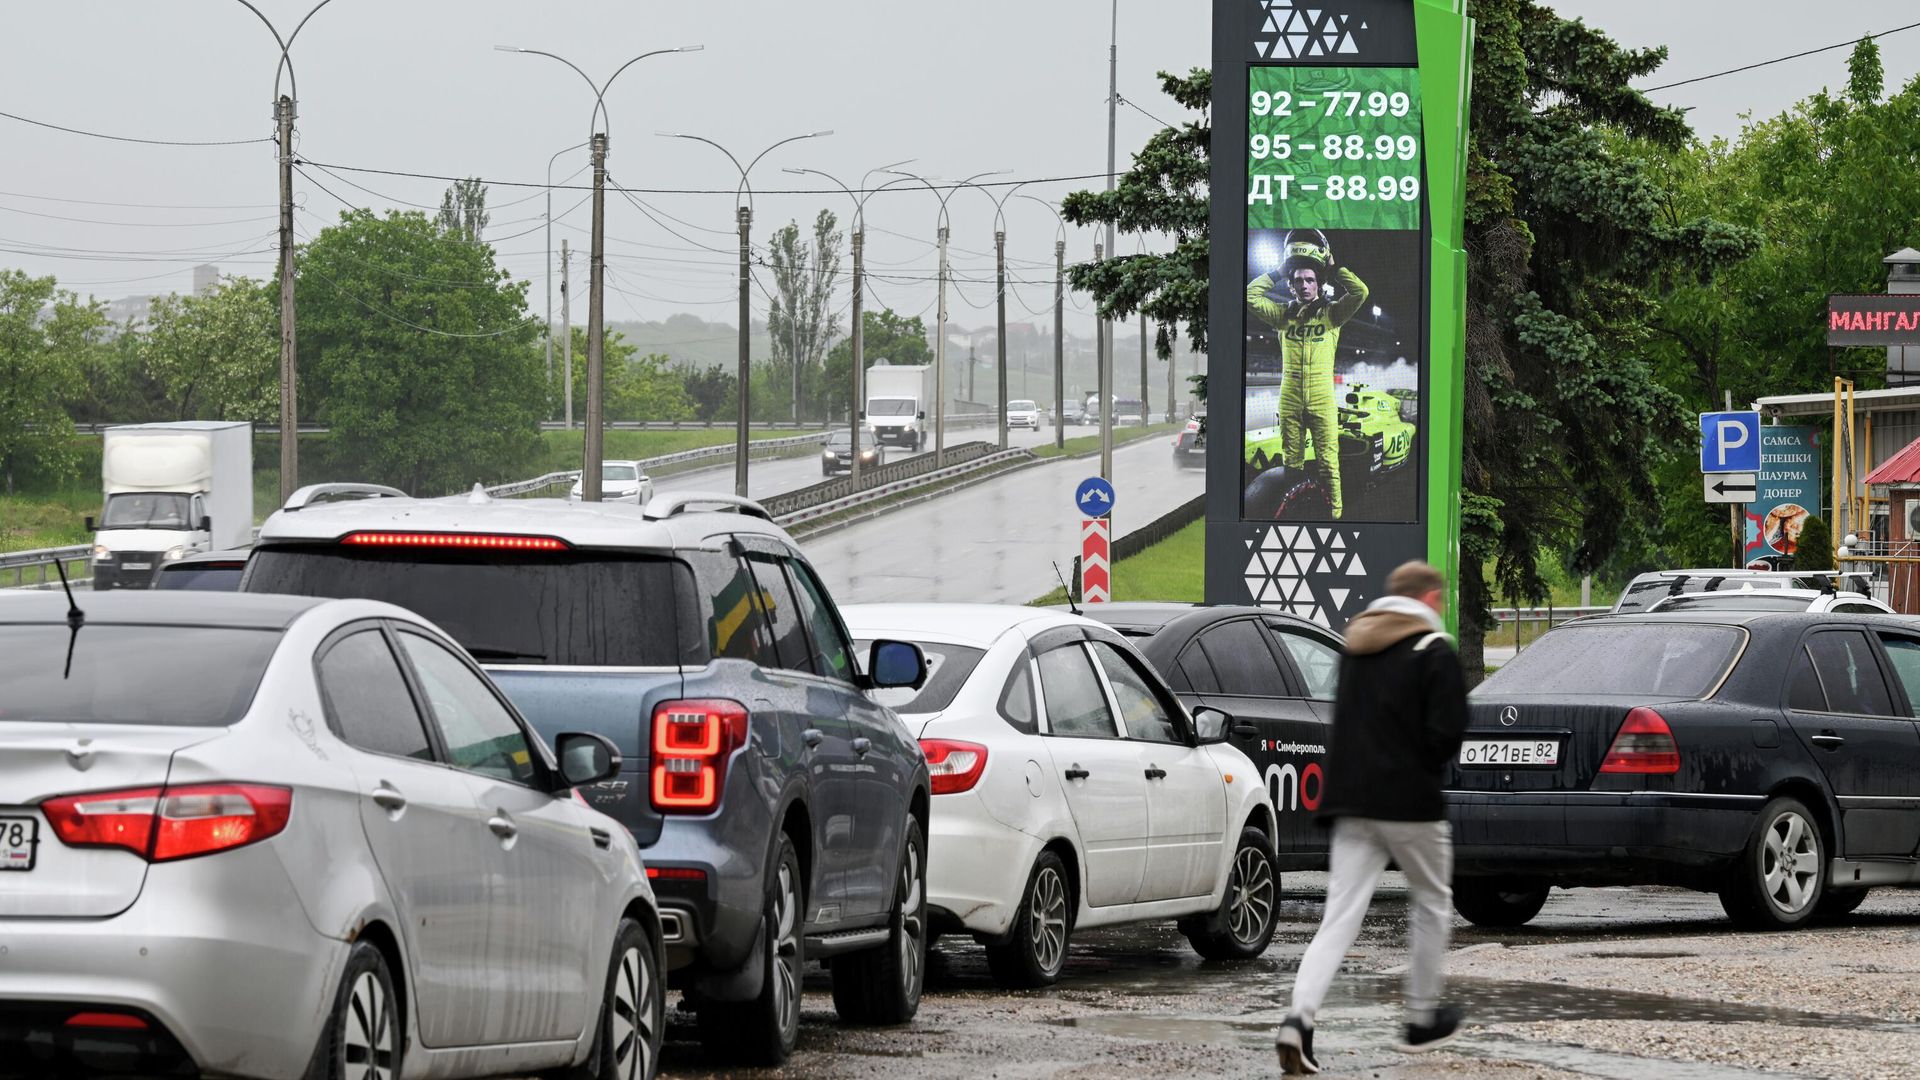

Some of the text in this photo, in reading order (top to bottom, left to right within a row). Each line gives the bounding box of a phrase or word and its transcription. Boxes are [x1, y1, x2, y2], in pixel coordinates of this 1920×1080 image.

[1251, 91, 1292, 117] 92
[1323, 92, 1410, 117] 77.99
[1250, 134, 1291, 160] 95
[1323, 135, 1417, 161] 88.99
[1248, 174, 1294, 205] ДТ
[1325, 175, 1420, 201] 88.99
[1763, 436, 1801, 446] САМСА
[1761, 453, 1812, 463] ЕПЕШКИ
[1758, 471, 1808, 481] ШАУРМА
[1763, 488, 1802, 499] ДОНЕР
[1261, 739, 1326, 755] Я Симферополь
[1536, 743, 1552, 757] 82
